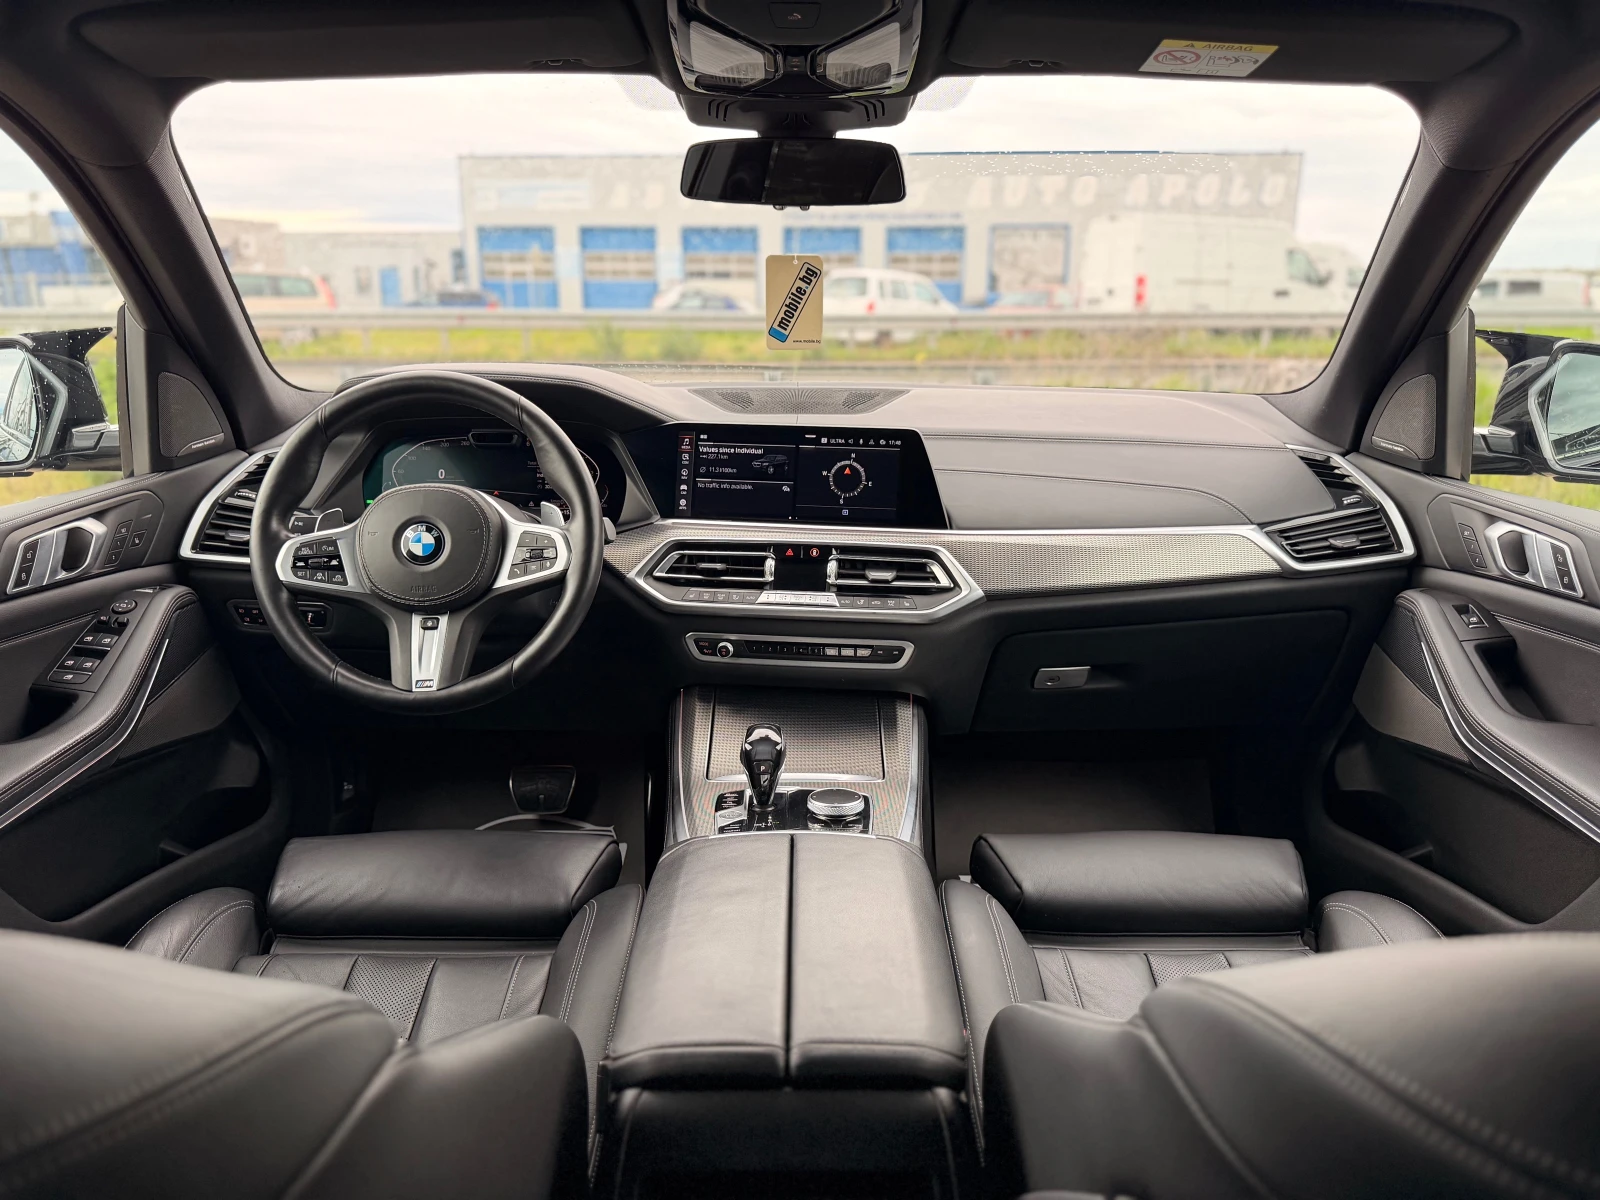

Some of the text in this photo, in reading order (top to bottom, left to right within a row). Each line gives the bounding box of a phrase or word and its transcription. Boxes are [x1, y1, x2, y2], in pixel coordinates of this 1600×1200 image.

[1202, 43, 1254, 52] AIRBAG
[967, 174, 1099, 208] AUTO
[1125, 173, 1288, 208] APOLO
[777, 266, 819, 332] mobile.bg
[438, 469, 445, 479] 0
[405, 525, 439, 538] BMW
[411, 585, 437, 593] AIRBAG
